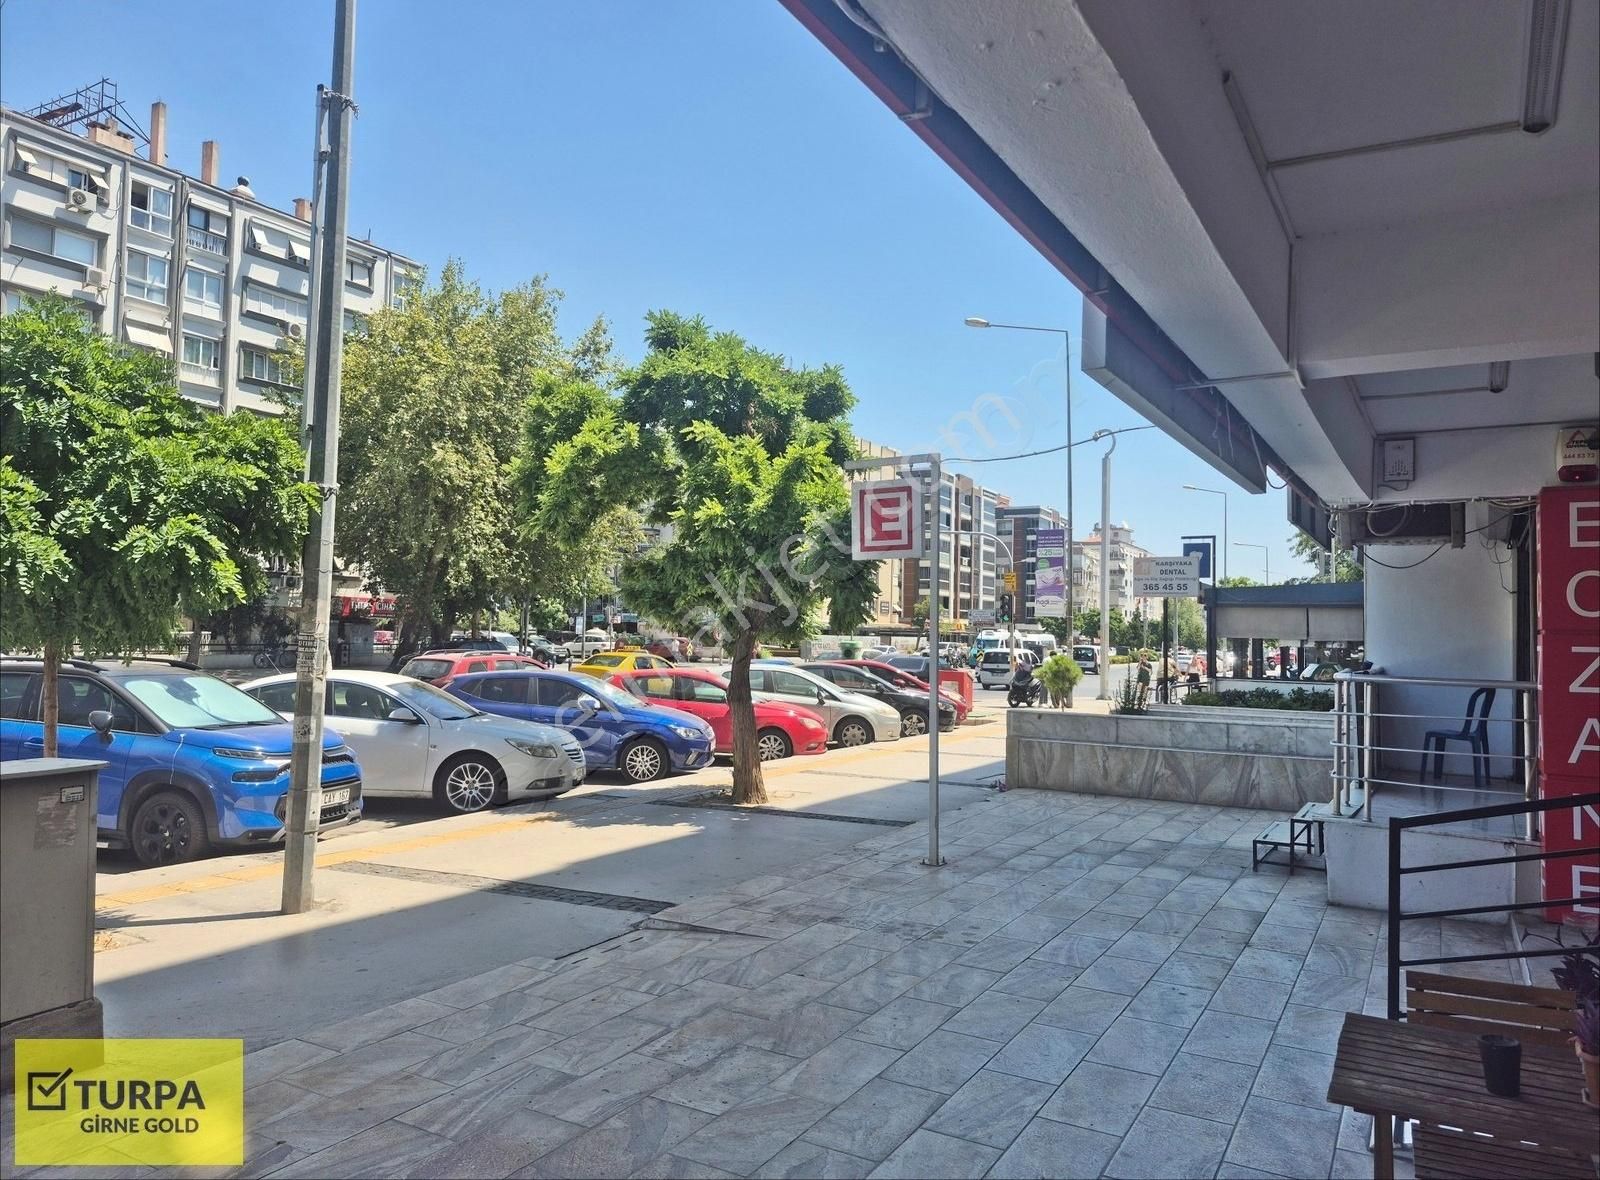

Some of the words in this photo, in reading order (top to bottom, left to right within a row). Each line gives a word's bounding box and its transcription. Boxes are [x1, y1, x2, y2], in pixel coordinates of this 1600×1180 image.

[1143, 583, 1160, 591] 365
[1162, 583, 1174, 591] 45
[1176, 583, 1188, 591] 55
